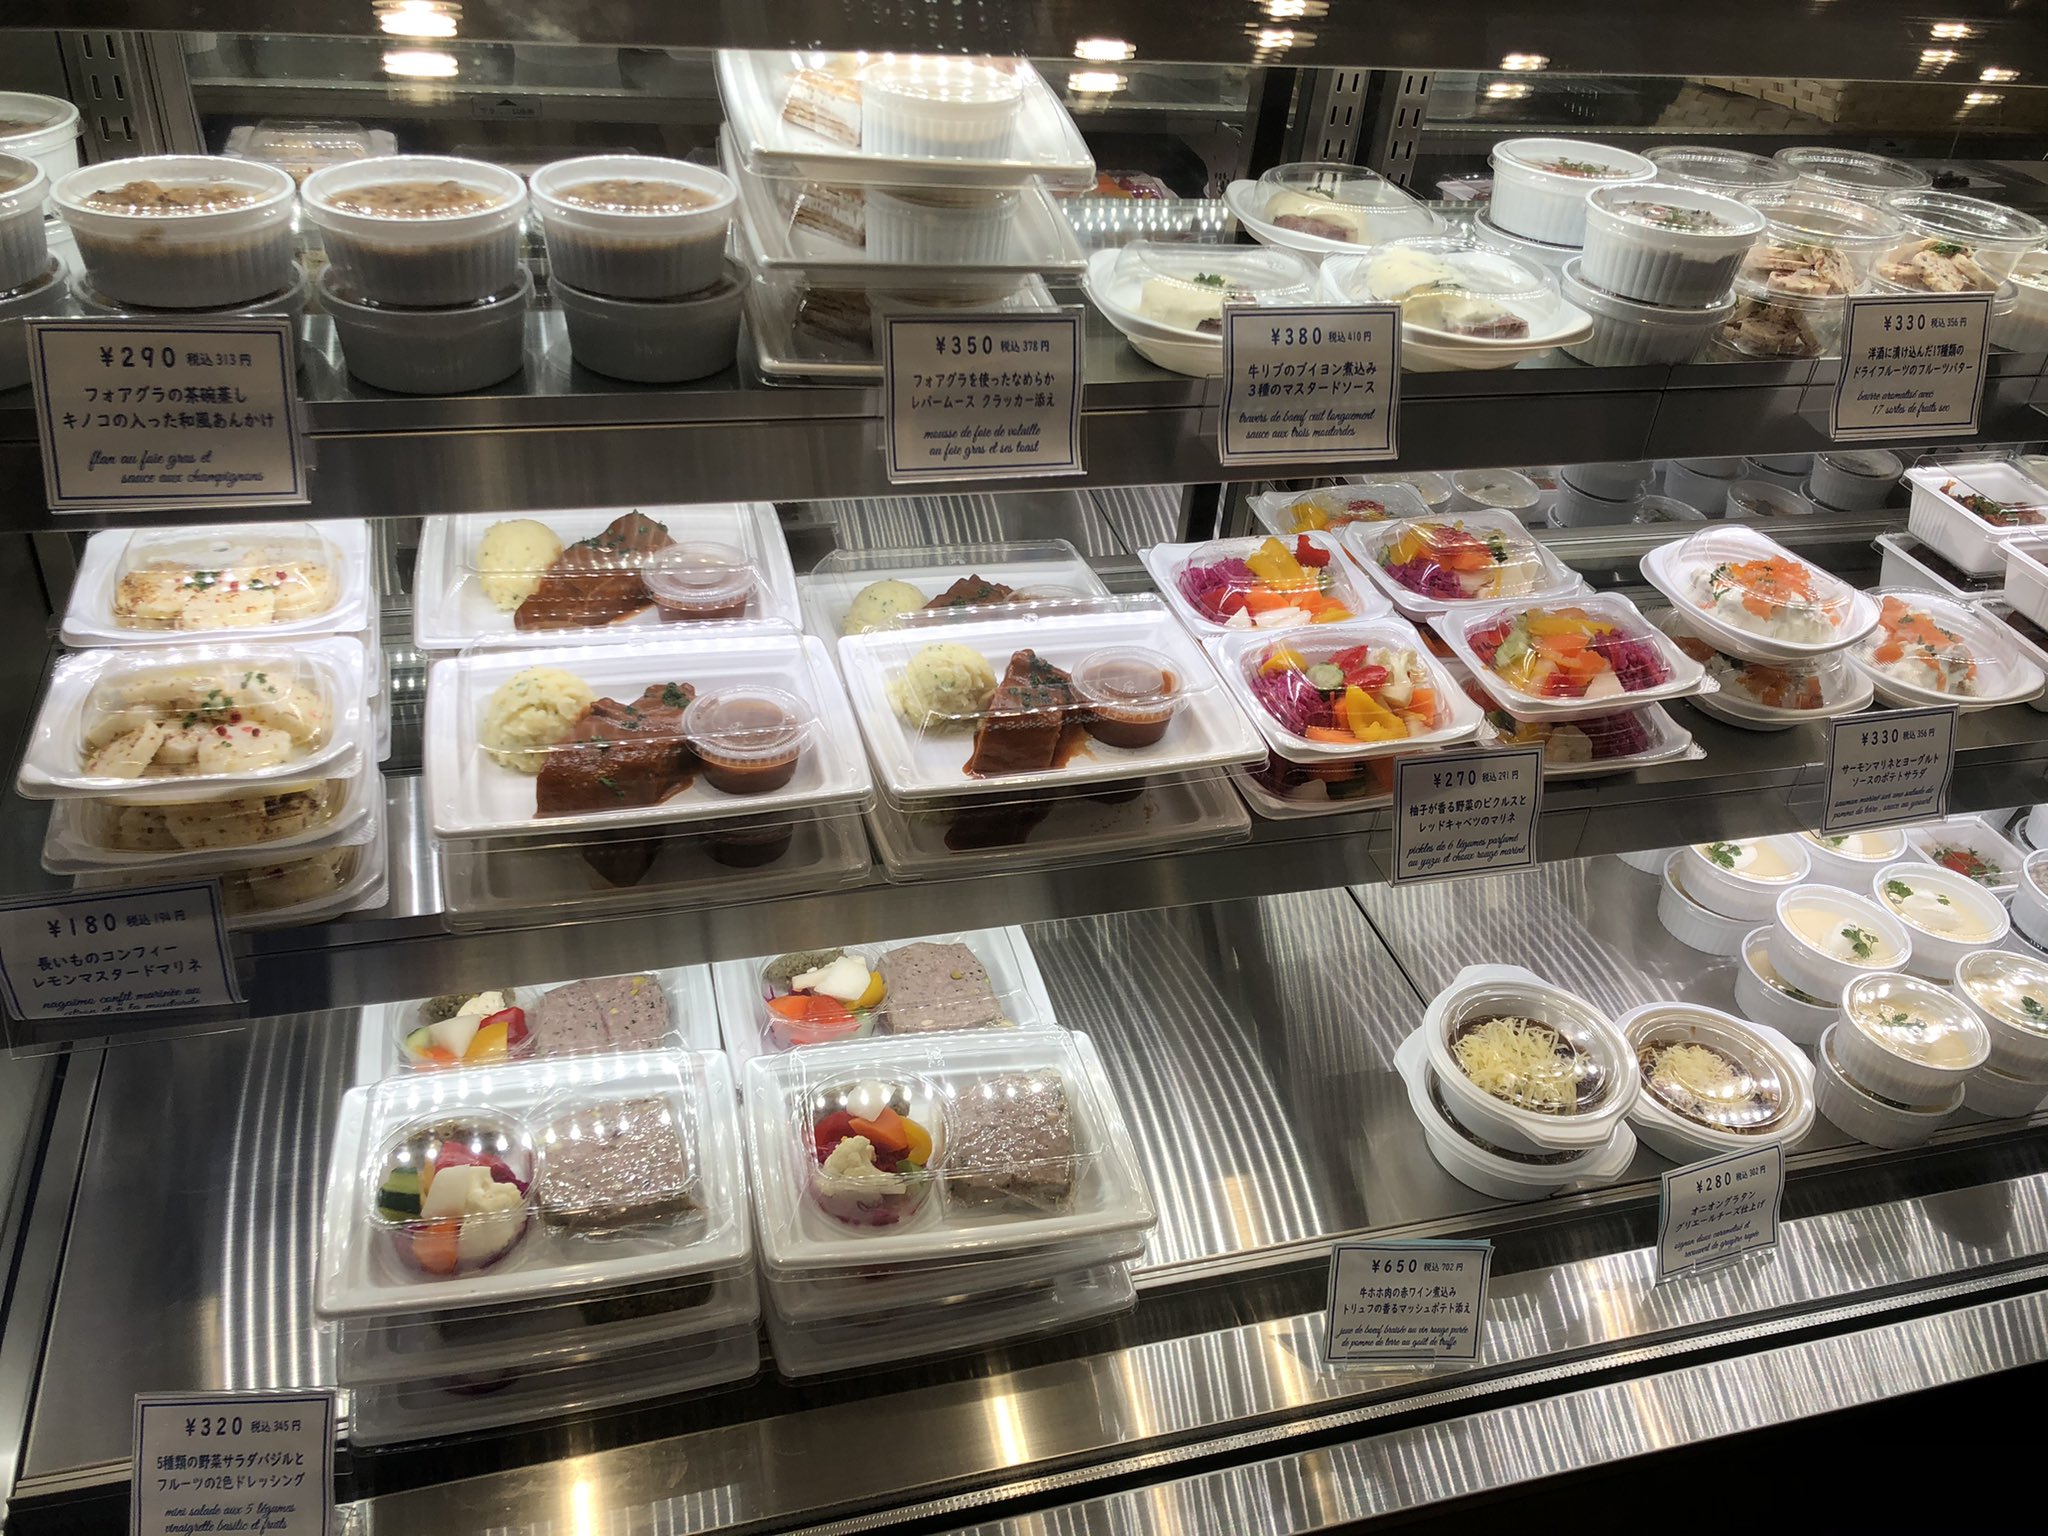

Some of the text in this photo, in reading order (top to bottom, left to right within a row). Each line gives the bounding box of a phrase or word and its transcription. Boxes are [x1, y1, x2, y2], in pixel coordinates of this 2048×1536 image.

[1884, 314, 1925, 331] ¥330
[1271, 327, 1322, 345] ¥380
[936, 336, 993, 355] ¥350
[100, 347, 176, 368] ¥290
[1248, 362, 1376, 378] 牛リブのブイヨン煮込み
[1853, 362, 1973, 379] ドライフルーツのフルーツバター
[913, 372, 1055, 388] フォアグラを使ったなめらか
[84, 387, 247, 405] フォアグラの茶碗蒸し
[1248, 381, 1375, 397] 3種のマスタードソース
[912, 395, 975, 409] レバームース
[1908, 403, 1917, 413] de
[63, 412, 275, 429] キノコの入った和風あんかけ
[1239, 411, 1267, 423] travers
[1270, 411, 1280, 422] de
[924, 423, 1040, 442] mousse de foie de volaille
[1246, 430, 1269, 439] sauce
[1291, 426, 1309, 437] trois
[1312, 426, 1355, 436] moutardes
[121, 455, 138, 465] au
[200, 450, 213, 463] et
[929, 447, 942, 456] au
[943, 444, 961, 461] foie
[965, 445, 985, 460] gras
[989, 442, 999, 453] et
[1000, 445, 1013, 453] ses
[1862, 729, 1899, 746] ¥330
[1841, 754, 1939, 774] サーモンマリネとヨーグルト
[1433, 770, 1476, 788] ¥270
[1852, 768, 1927, 787] ソースのポテトサラダ
[1410, 796, 1526, 817] 柚子が香る野菜のピクルスと
[1419, 812, 1516, 833] レッドキャベツのマリネ
[1436, 841, 1446, 851] de
[1443, 853, 1451, 862] et
[48, 913, 116, 937] ¥180
[37, 945, 178, 971] 長いものコンフィー
[33, 959, 202, 988] レモンマスタードマリネ
[1696, 1172, 1731, 1193] ¥280
[1691, 1191, 1756, 1215] オニオングラタン
[1372, 1259, 1417, 1273] ¥650
[1360, 1287, 1456, 1299] 牛ホホ肉の赤ワイン煮込み
[1343, 1302, 1471, 1315] トリュフの香るマッシュポテト添え
[1355, 1325, 1363, 1333] de
[1341, 1338, 1349, 1346] de
[1376, 1338, 1384, 1346] de
[1430, 1337, 1438, 1345] de
[185, 1417, 243, 1436] ¥320
[157, 1452, 304, 1470] 5種類の野菜サラダバジルと
[157, 1472, 305, 1491] フルーツの2色ドレッシング
[165, 1507, 187, 1517] mini
[189, 1504, 221, 1516] salade
[223, 1505, 243, 1515] aux
[250, 1519, 260, 1530] et
